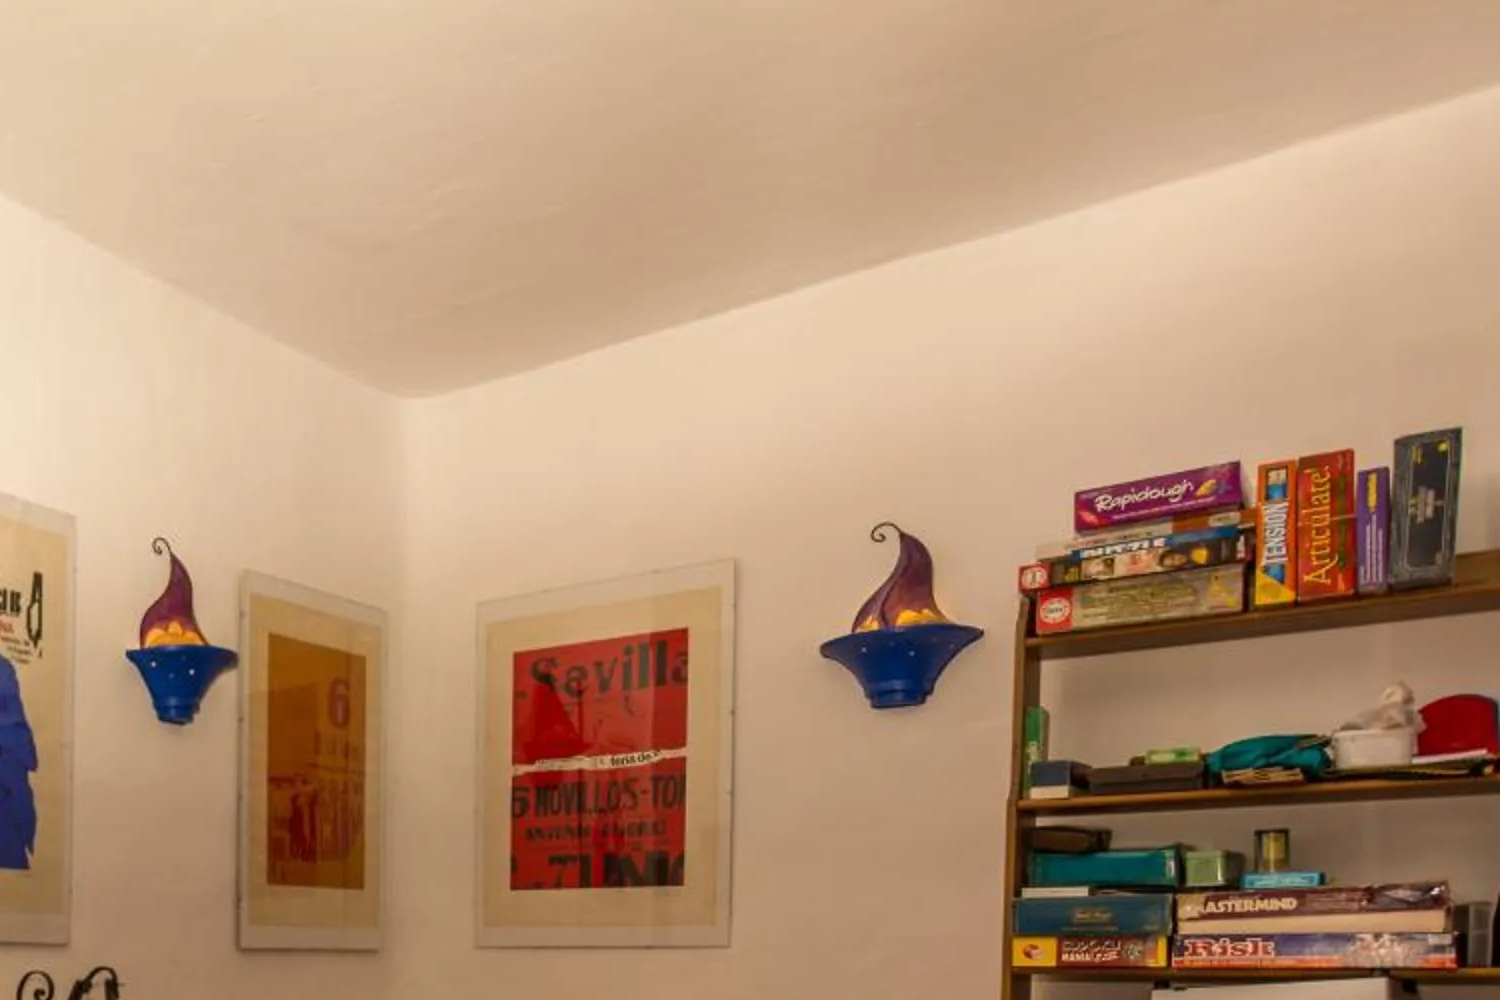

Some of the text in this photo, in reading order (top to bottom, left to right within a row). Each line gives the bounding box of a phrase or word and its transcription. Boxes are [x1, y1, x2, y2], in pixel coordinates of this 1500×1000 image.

[1094, 479, 1194, 513] Rapidough
[1262, 502, 1289, 566] TENSION
[1304, 465, 1338, 586] Articulate!
[1183, 937, 1275, 959] Risk
